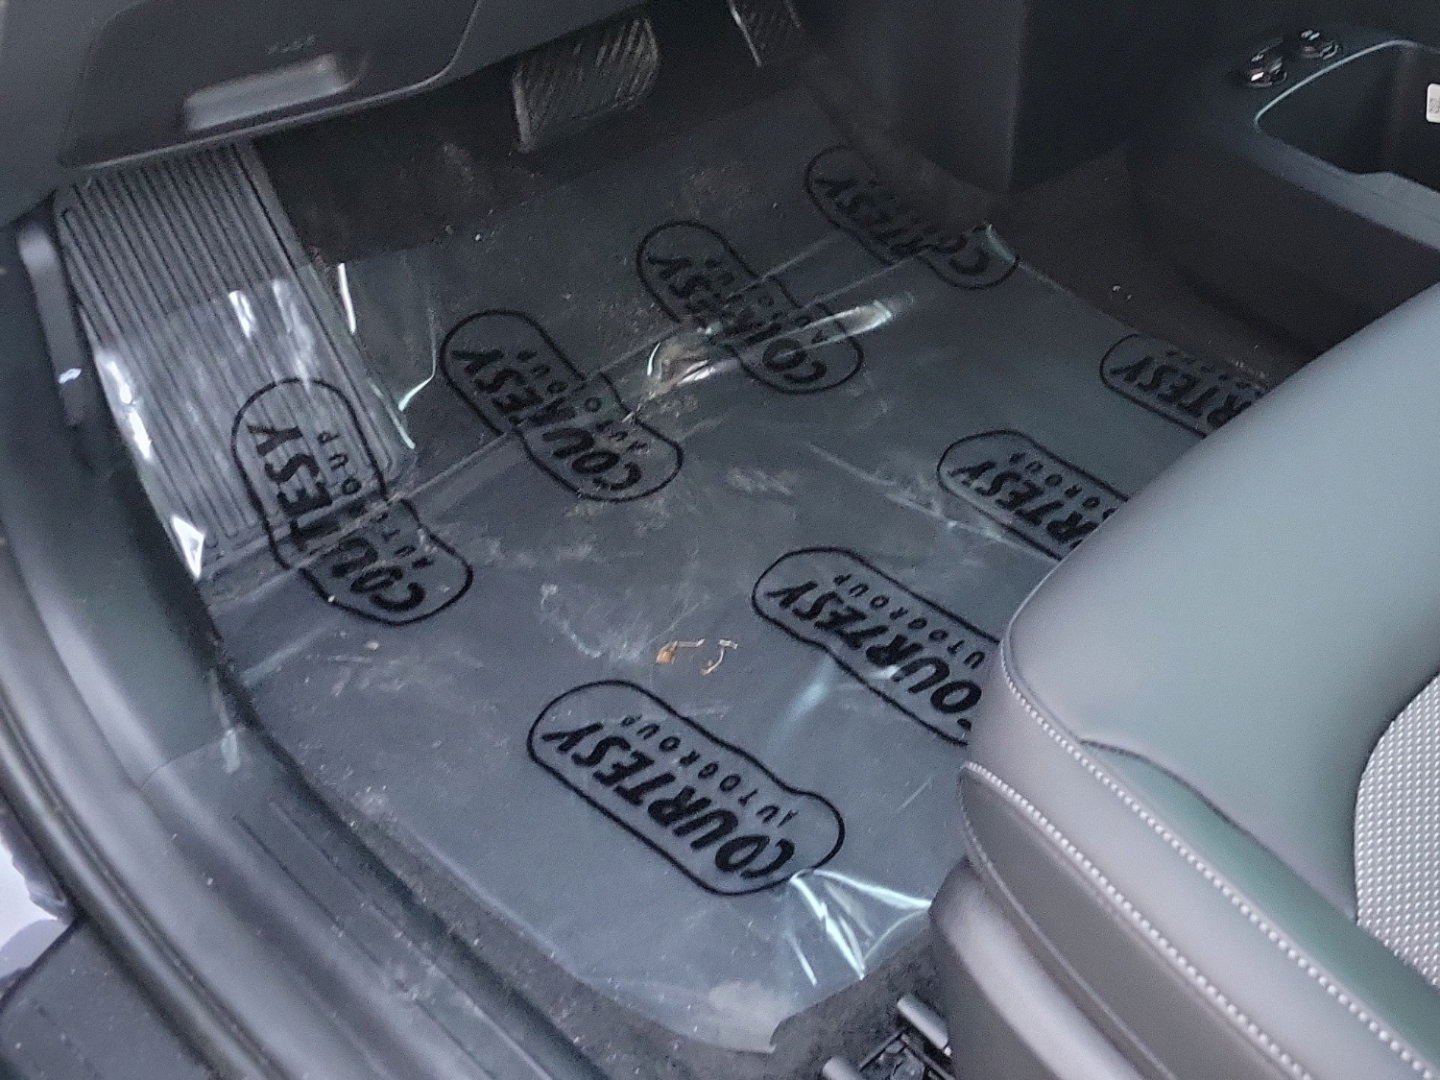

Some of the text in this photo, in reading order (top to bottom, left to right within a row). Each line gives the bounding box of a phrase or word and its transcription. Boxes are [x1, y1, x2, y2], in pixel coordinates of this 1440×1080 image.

[833, 573, 986, 670] UTOGROUP
[541, 722, 796, 880] COURTESY
[620, 714, 798, 829] AUTOGROUP
